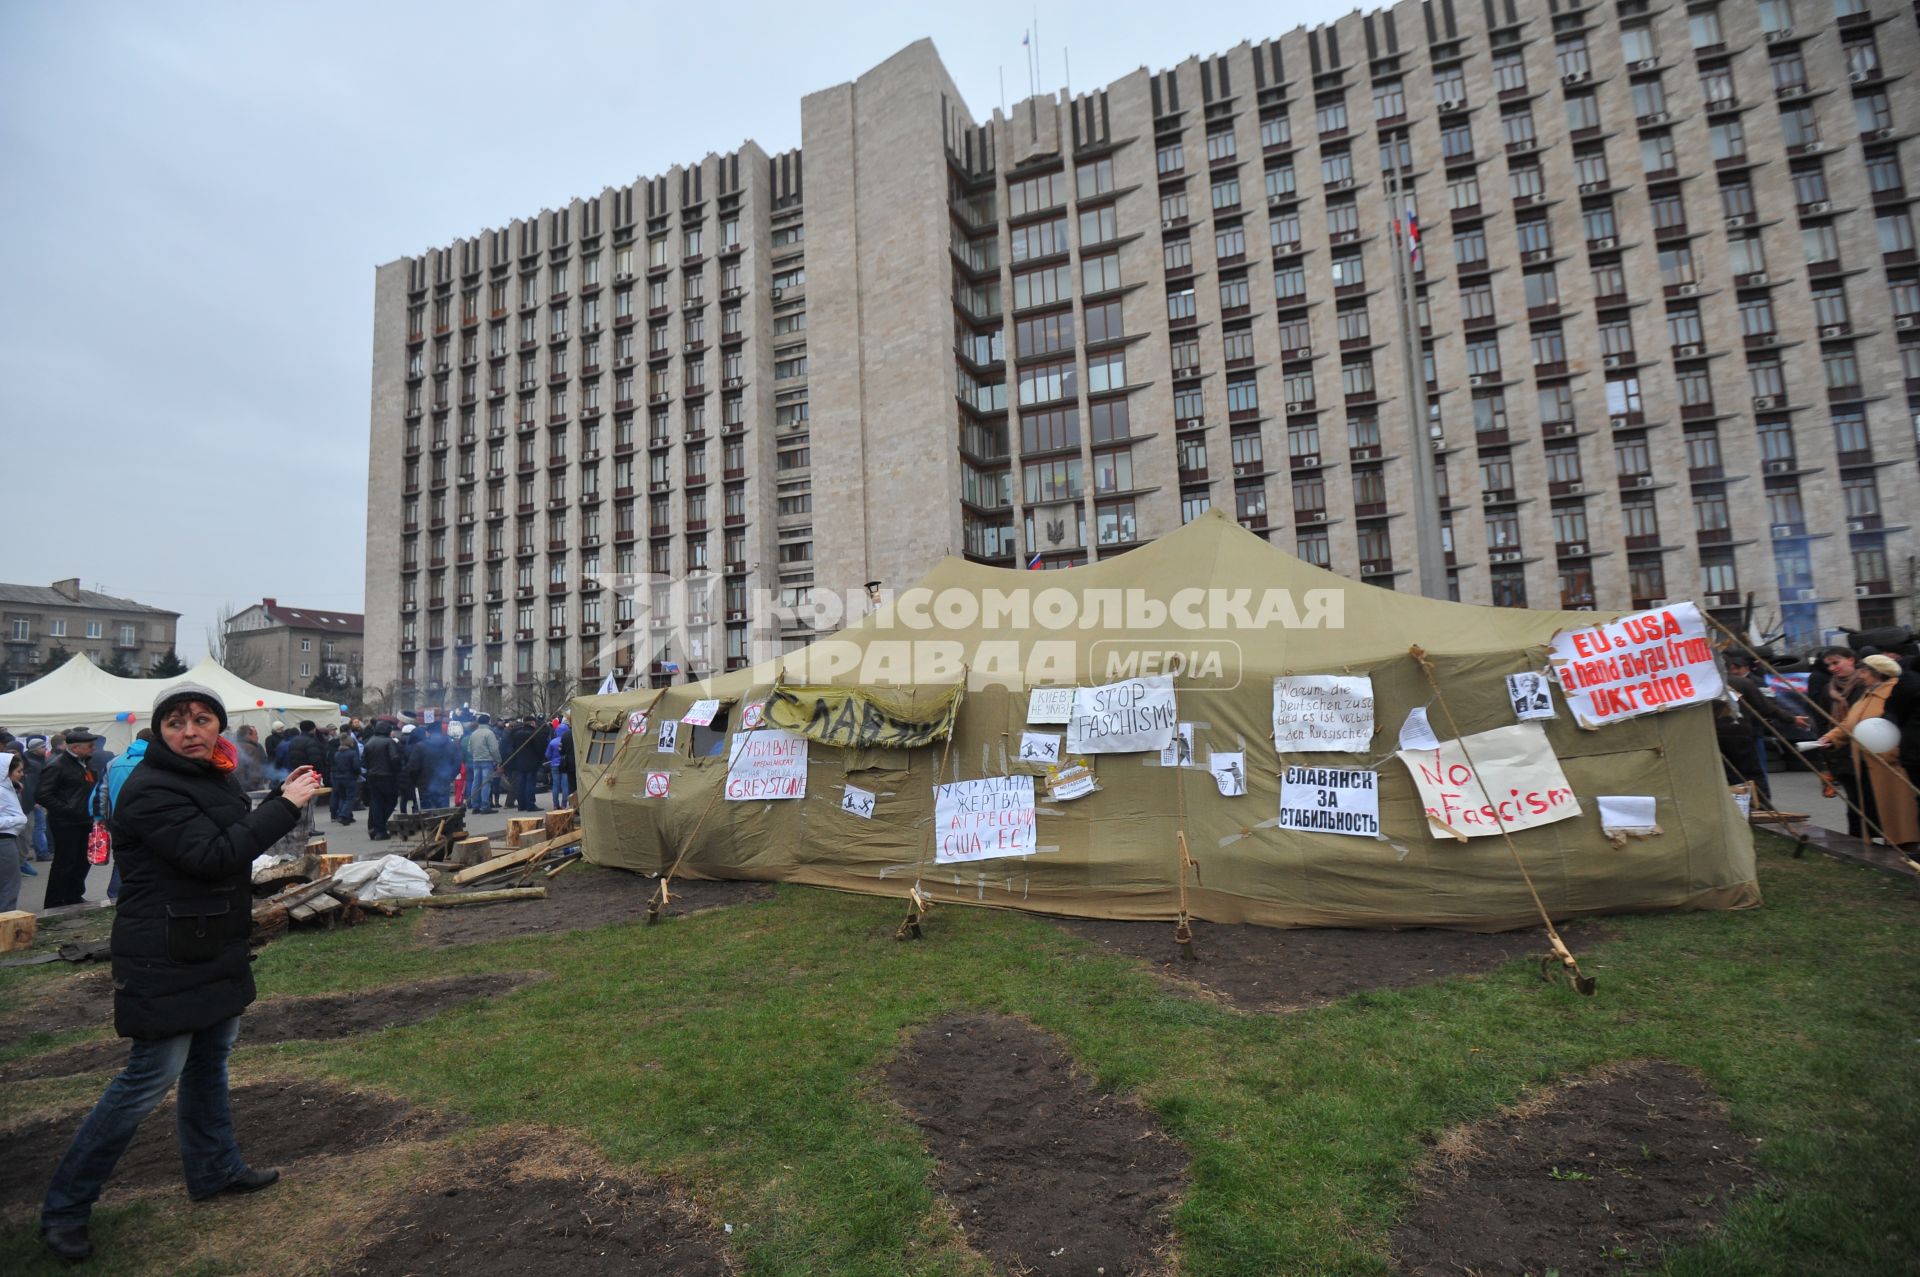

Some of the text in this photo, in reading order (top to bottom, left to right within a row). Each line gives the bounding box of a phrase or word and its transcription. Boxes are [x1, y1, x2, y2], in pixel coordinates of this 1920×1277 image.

[1572, 611, 1683, 658] EU & USA
[1559, 637, 1712, 691] a hand away from
[1093, 683, 1145, 712] STOP
[1280, 683, 1352, 697] Warum die
[1280, 698, 1342, 713] Deutschen
[1079, 700, 1175, 741] FASCHISM!
[1302, 713, 1315, 723] es
[1320, 712, 1335, 723] ist
[745, 738, 805, 758] УБИВАЕТ
[1285, 767, 1373, 789] СЛАВЯНСК
[1418, 748, 1472, 786] No
[728, 775, 807, 798] GREYSTONE
[941, 774, 1030, 799] УКРАИНА
[957, 791, 1021, 813] ЖЕРТВА
[1317, 789, 1338, 808] ЗА
[951, 808, 1035, 829] АГРЕССИИ
[1280, 807, 1378, 833] СТАБИЛЬНОСТЬ
[944, 833, 981, 856] США
[998, 824, 1032, 849] ЕС!
